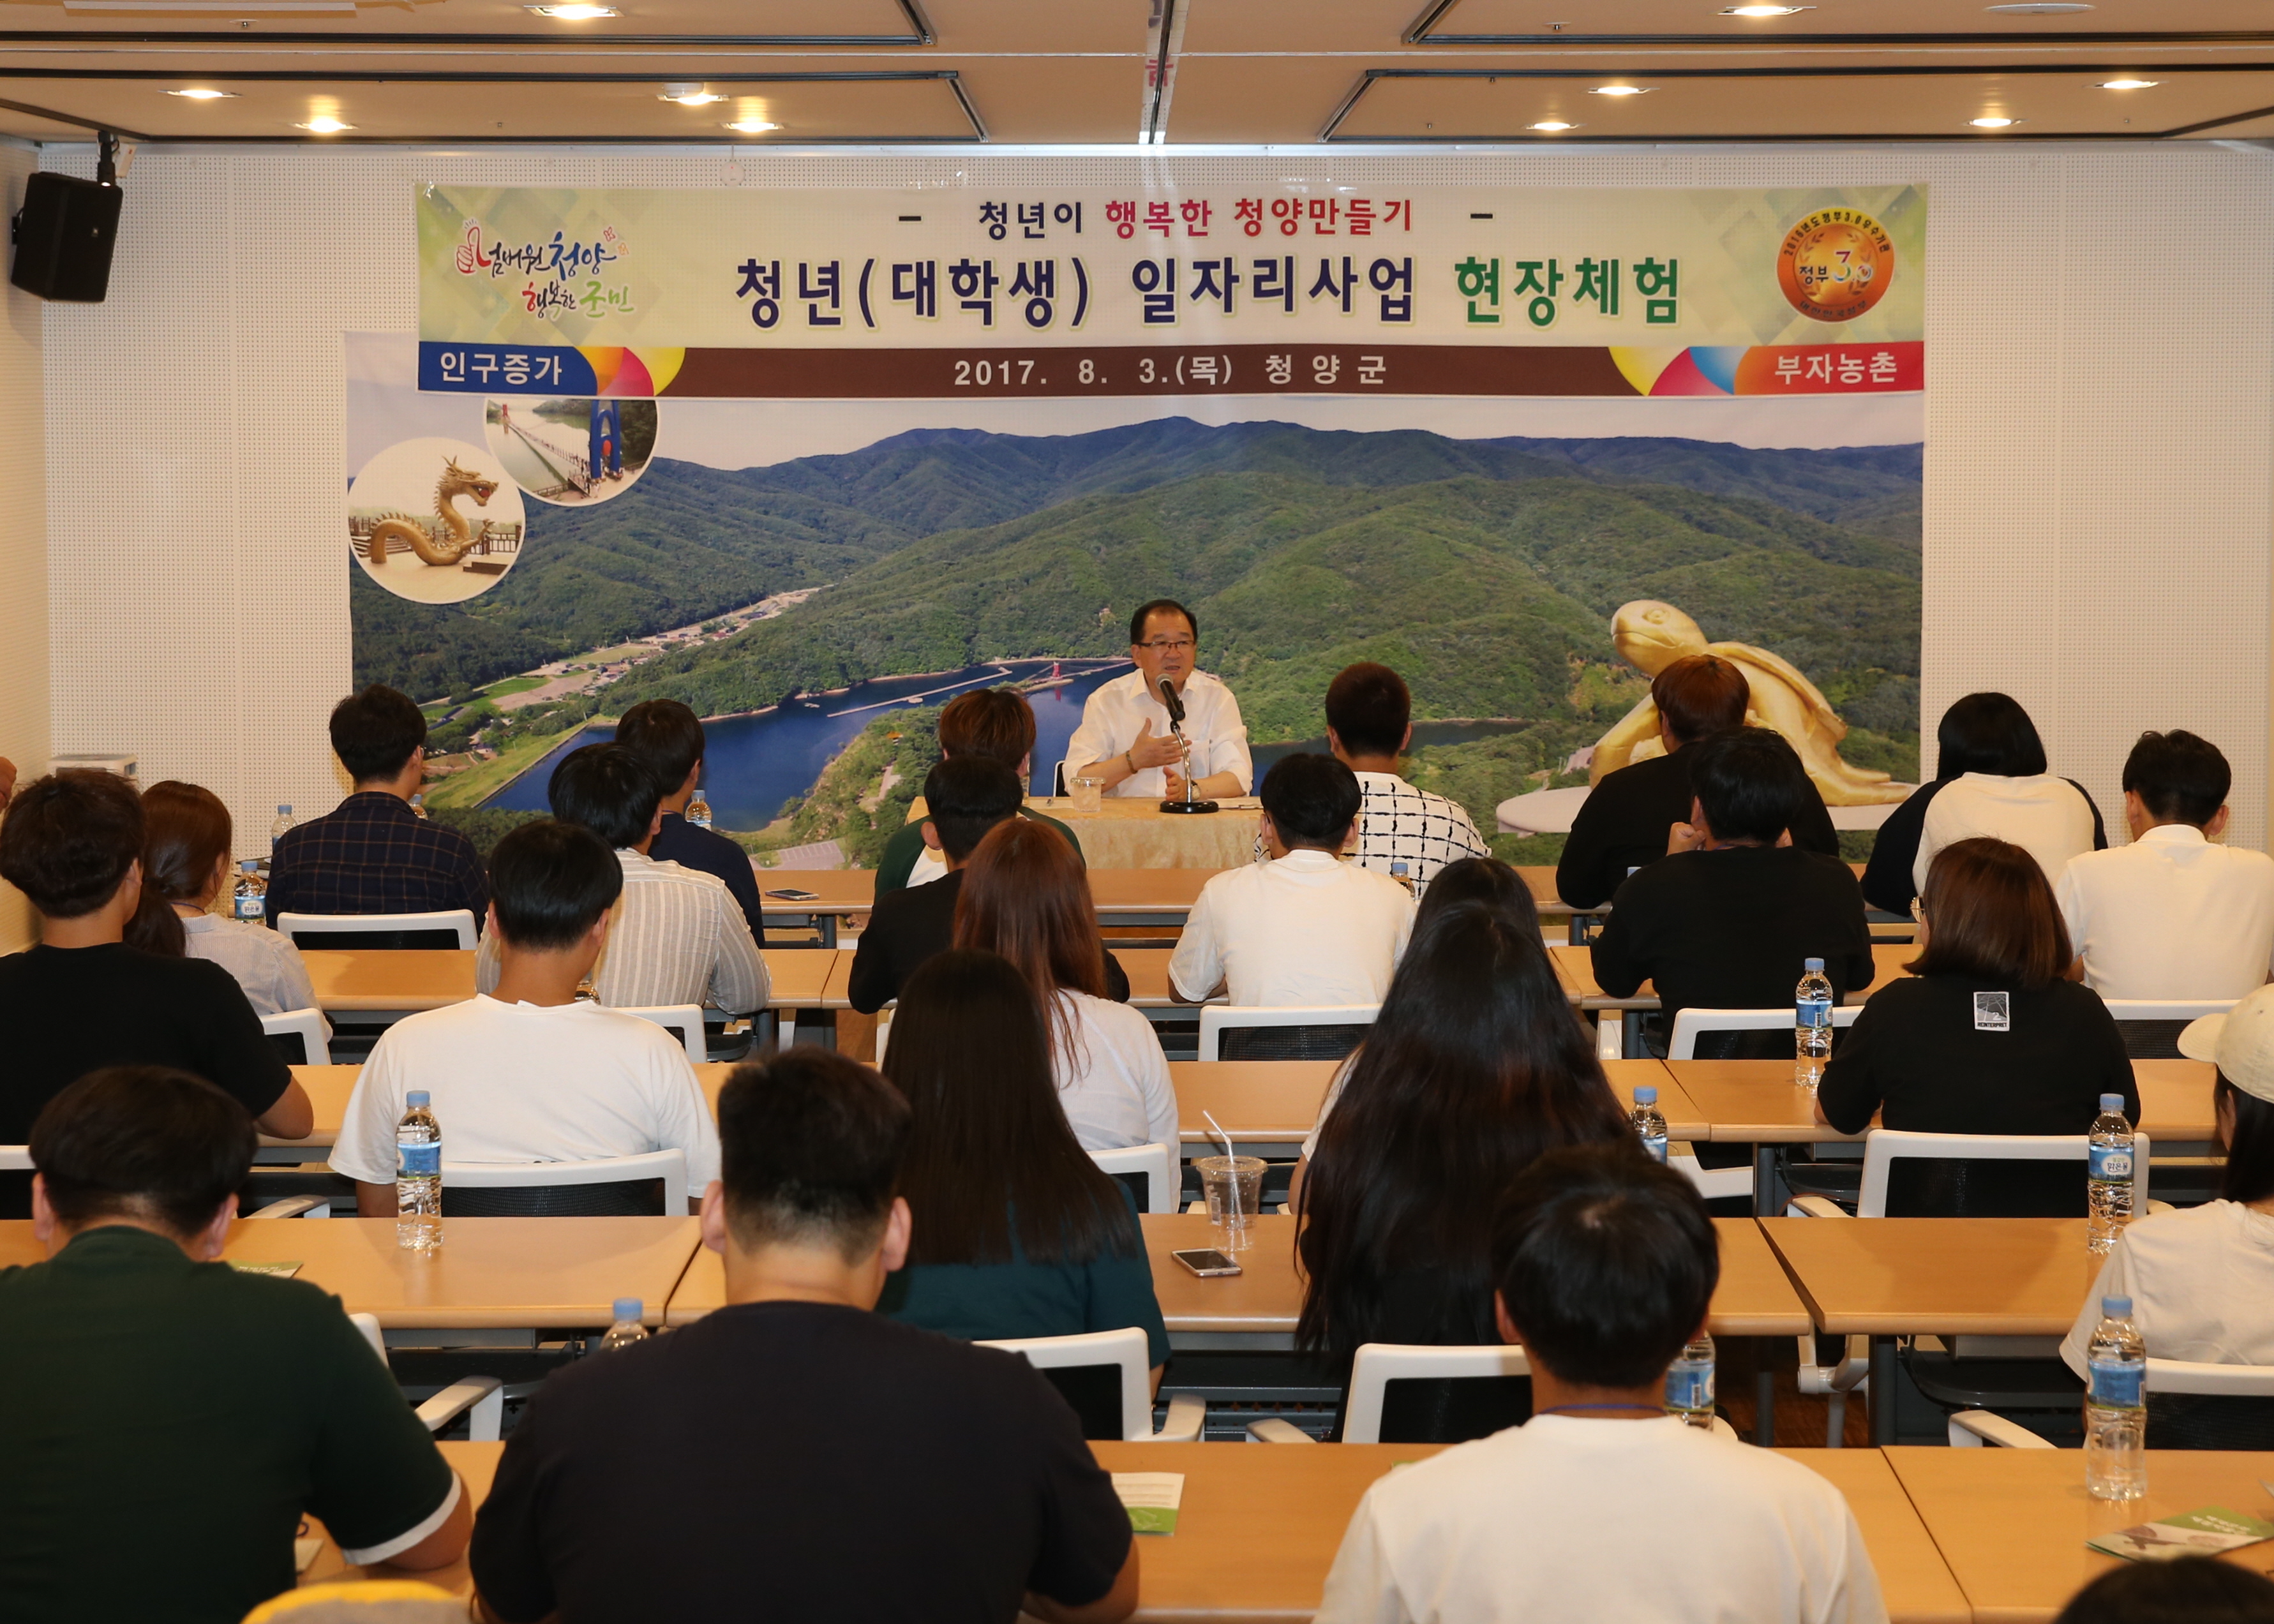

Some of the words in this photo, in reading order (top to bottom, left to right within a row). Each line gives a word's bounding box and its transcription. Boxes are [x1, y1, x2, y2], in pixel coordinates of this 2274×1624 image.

[979, 200, 1082, 240] 청년이
[1105, 199, 1213, 239] 행복한
[1234, 198, 1412, 237] 청양만들기
[549, 231, 617, 281] 청양
[522, 279, 576, 318] 행복한
[580, 280, 634, 318] 군민
[737, 257, 1088, 329] 청년(대학생)
[1132, 256, 1413, 324] 일자리사업
[1454, 256, 1678, 326] 현장체험
[440, 351, 562, 385] 인구증가
[955, 359, 1047, 385] 2017.
[1079, 359, 1107, 384] 8.
[1139, 354, 1233, 385] 3.(목)
[1774, 352, 1898, 384] 부자농촌
[1993, 1012, 2001, 1020] 2
